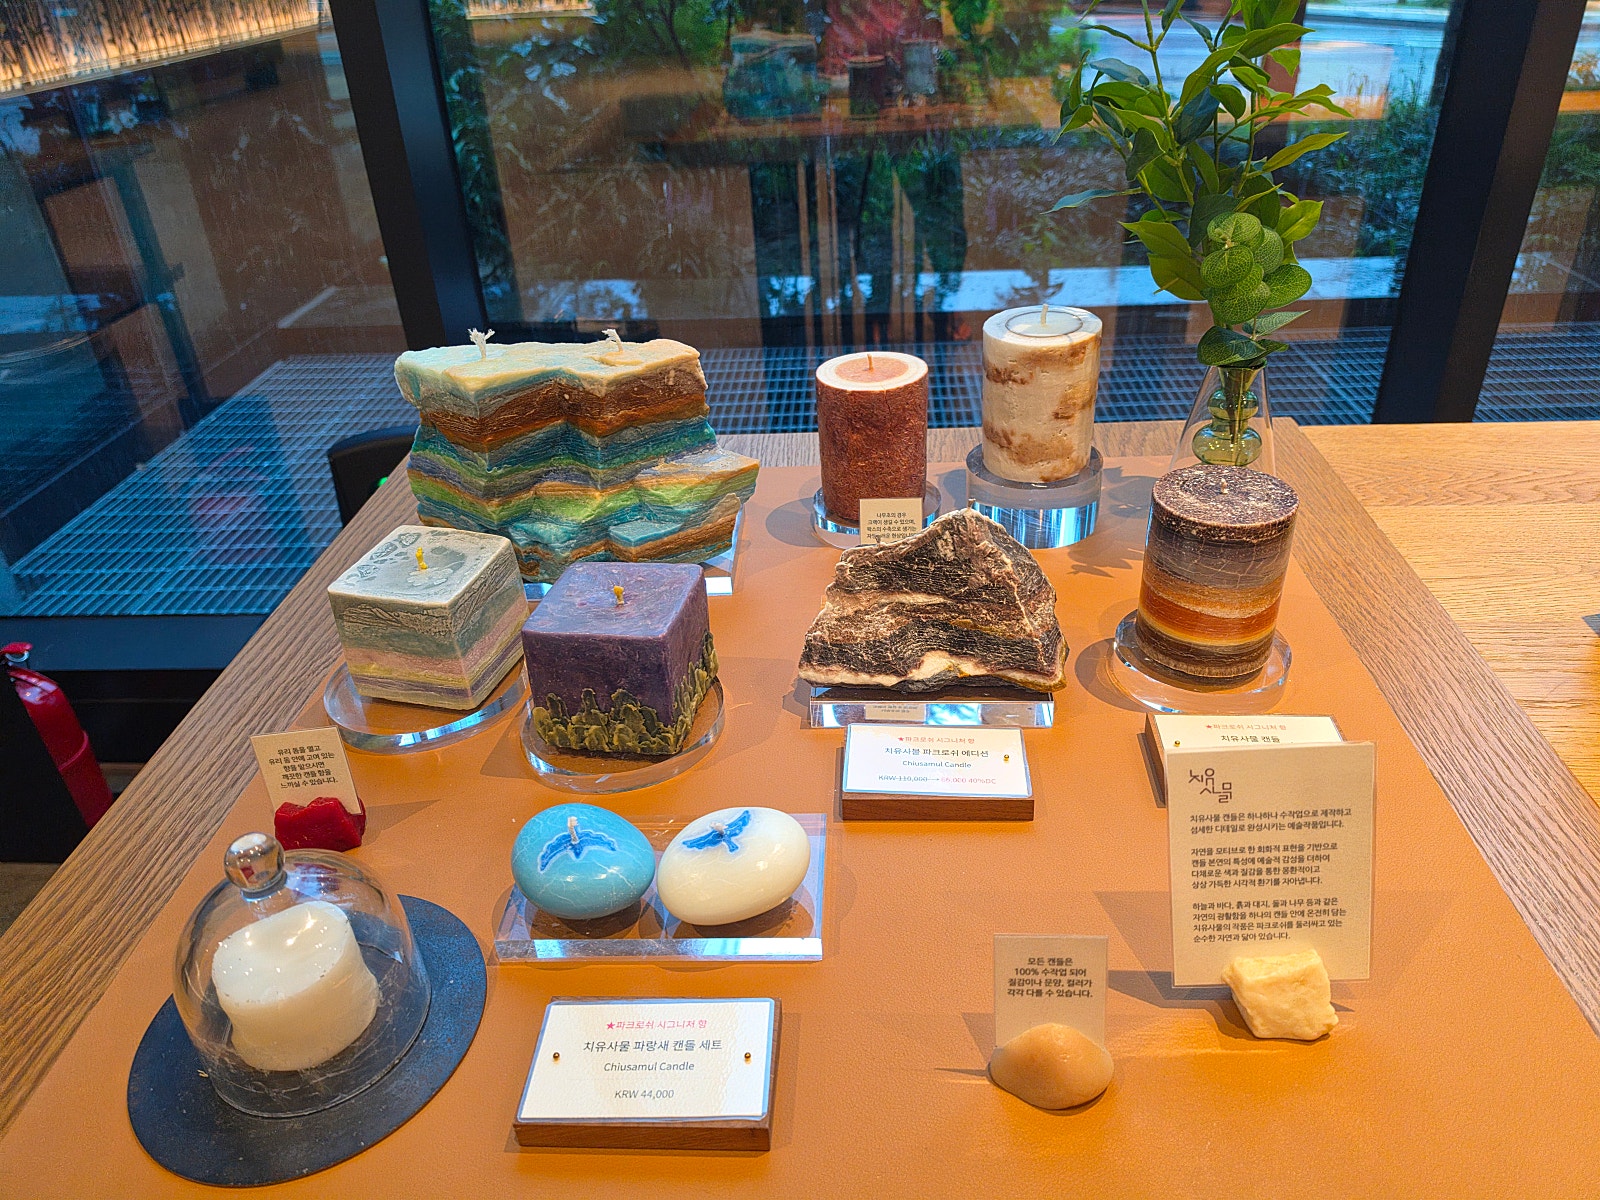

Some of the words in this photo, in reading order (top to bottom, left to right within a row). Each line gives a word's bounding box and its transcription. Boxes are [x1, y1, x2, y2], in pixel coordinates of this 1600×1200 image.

[278, 748, 291, 756] 유리
[269, 757, 282, 765] 유리
[298, 762, 324, 770] 맡으시면
[281, 780, 300, 788] 느끼실
[1190, 814, 1220, 823] 치유사물
[1222, 813, 1245, 822] 캔들은
[1247, 811, 1278, 820] 하나하나
[1280, 810, 1318, 818] 수작업으로
[1320, 808, 1351, 817] 제작하고
[1191, 825, 1212, 834] 섬세한
[1215, 824, 1246, 833] 디테일로
[1247, 822, 1285, 831] 완성시키는
[1288, 820, 1344, 830] 예술작품입니다.
[1191, 847, 1213, 856] 자연을
[1215, 847, 1246, 855] 모티브로
[1248, 846, 1255, 854] 한
[1257, 844, 1280, 853] 회화적
[1282, 844, 1304, 852] 표현을
[1307, 842, 1338, 851] 기반으로
[1192, 859, 1206, 867] 캔들
[1208, 858, 1231, 866] 본연의
[1233, 857, 1255, 865] 특성에
[1257, 856, 1280, 864] 예술적
[1282, 855, 1304, 863] 감성을
[1307, 854, 1330, 862] 더하여
[1192, 869, 1222, 878] 다채로운
[1223, 868, 1238, 877] 색과
[1241, 867, 1263, 876] 질감을
[1265, 867, 1280, 875] 통한
[1282, 866, 1320, 874] 몽환적이고
[1192, 880, 1207, 889] 상상
[1209, 879, 1231, 888] 가득한
[1233, 879, 1256, 887] 시각적
[1258, 878, 1280, 886] 환기를
[1282, 877, 1322, 885] 자아냅니다.
[1193, 901, 1214, 910] 하늘과
[1236, 901, 1250, 909] 흙과
[1272, 900, 1287, 908] 돌과
[1289, 899, 1304, 907] 나무
[1306, 898, 1321, 906] 등과
[1323, 897, 1338, 905] 같은
[1193, 912, 1215, 921] 자연의
[1217, 911, 1246, 920] 광활함을
[1249, 911, 1271, 919] 하나의
[1274, 910, 1288, 918] 캔들
[1290, 910, 1304, 918] 안에
[1307, 909, 1329, 917] 온전히
[1331, 908, 1347, 916] 담는
[1193, 923, 1230, 932] 치유사물의
[1232, 922, 1254, 931] 작품은
[1256, 921, 1293, 930] 파크로쉬를
[1296, 920, 1326, 929] 둘러싸고
[1328, 919, 1342, 927] 있는
[1193, 934, 1215, 943] 순수한
[1217, 934, 1239, 942] 자연과
[1241, 932, 1256, 941] 닮아
[1259, 932, 1290, 940] 있습니다.
[1028, 958, 1044, 966] 모든
[1047, 957, 1073, 966] 캔들은
[1041, 968, 1067, 976] 수작업
[1070, 968, 1086, 976] 되어
[1009, 979, 1042, 987] 질감이나
[1067, 979, 1092, 987] 컬러가
[1026, 989, 1043, 997] 다를
[616, 1020, 654, 1030] 파크로쉬
[657, 1020, 695, 1029] 시그니처
[699, 1020, 706, 1028] 향
[584, 1040, 629, 1052] 치유사물
[633, 1040, 669, 1051] 파랑새
[673, 1039, 696, 1051] 캔들
[699, 1040, 723, 1051] 세트
[604, 1062, 657, 1071] Chiusamul
[660, 1062, 694, 1071] Candle
[615, 1090, 637, 1098] KRW
[641, 1090, 674, 1099] 44,000
